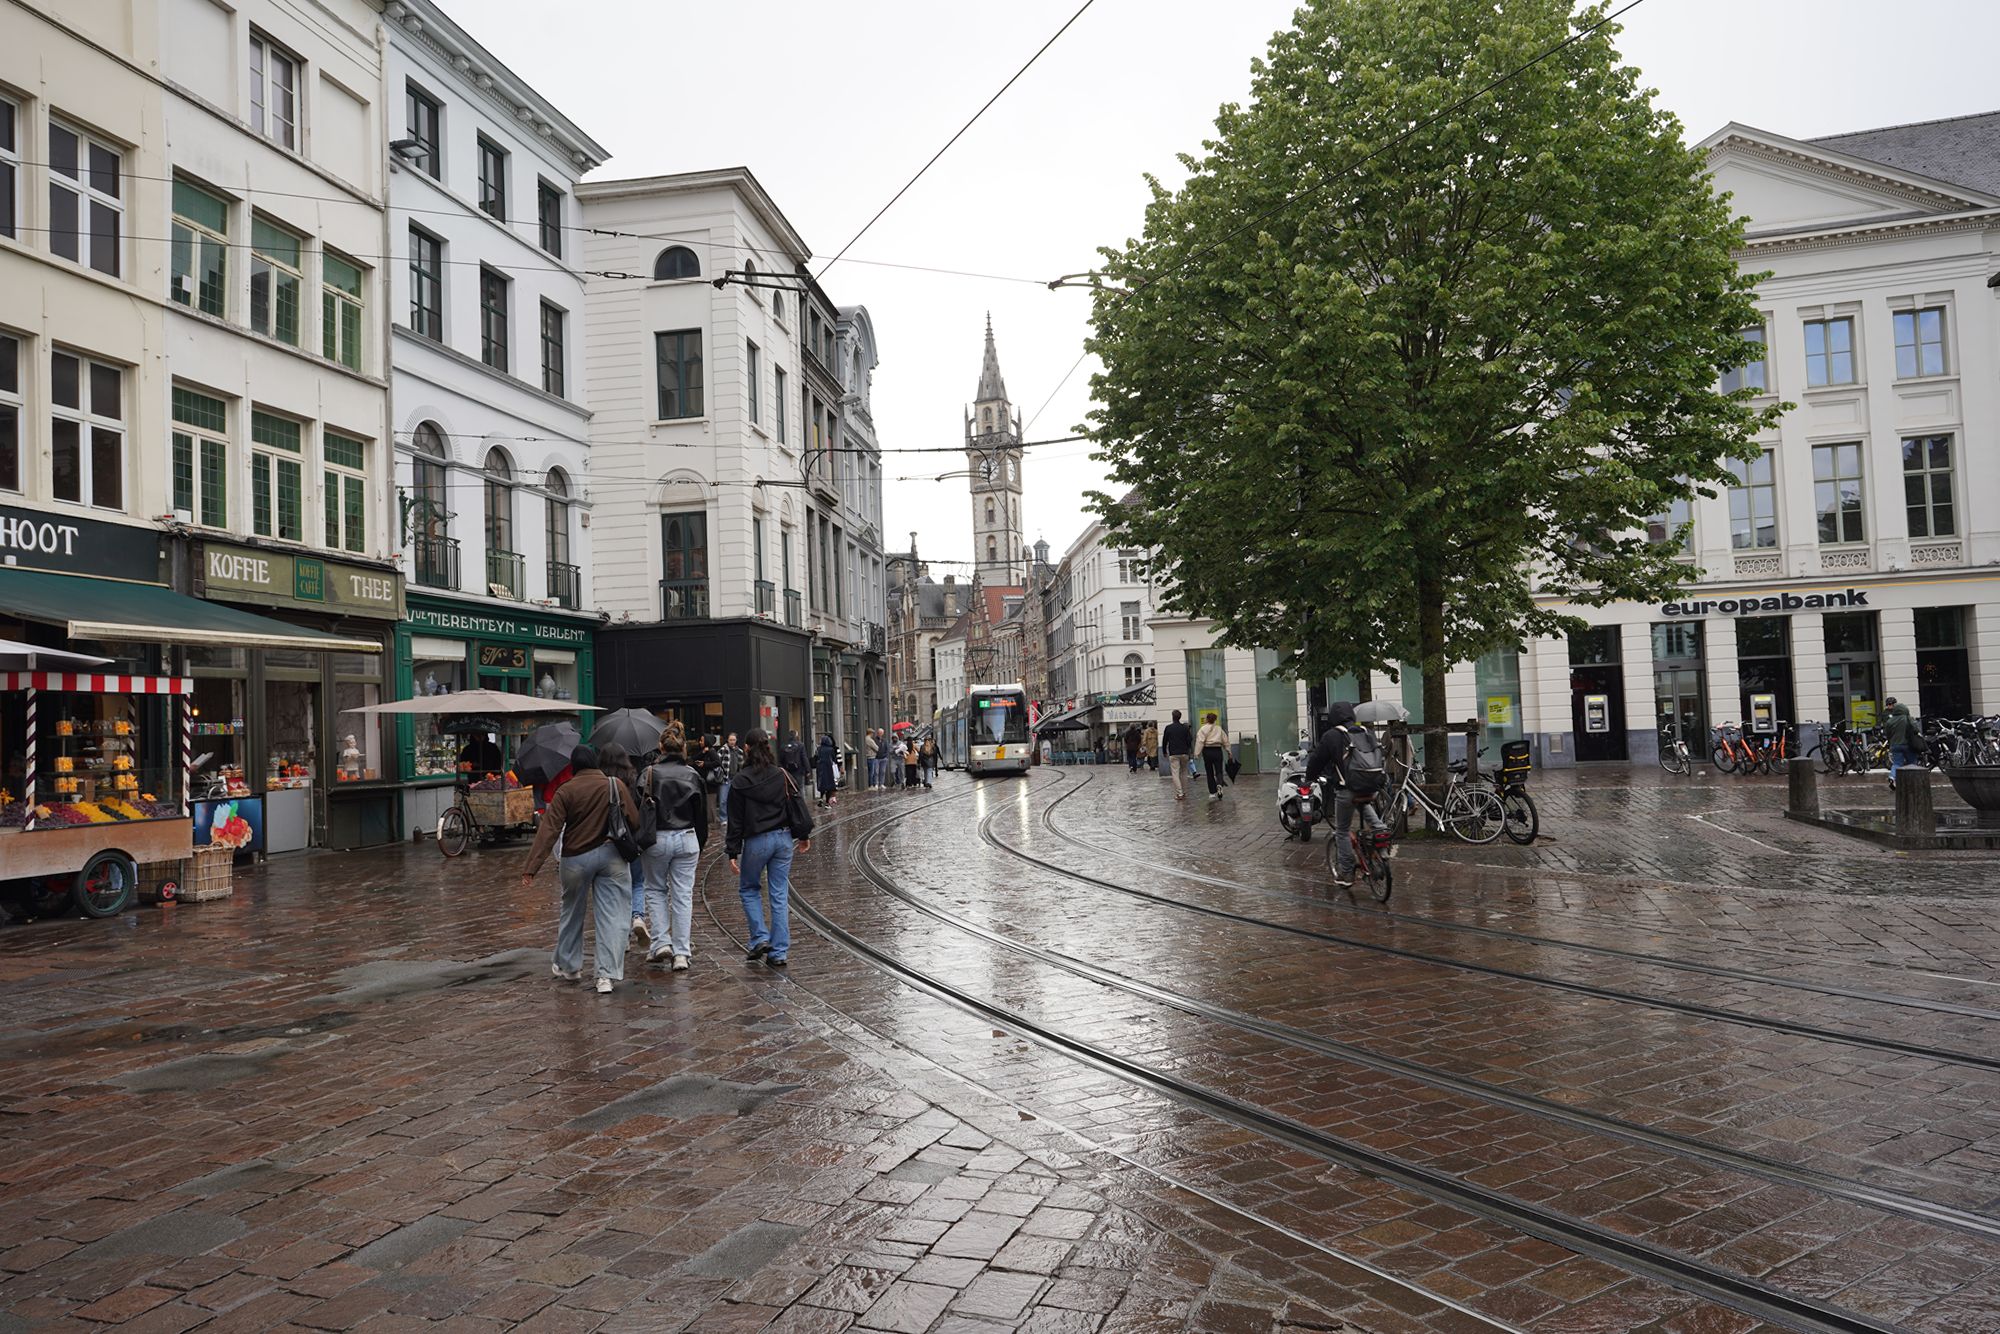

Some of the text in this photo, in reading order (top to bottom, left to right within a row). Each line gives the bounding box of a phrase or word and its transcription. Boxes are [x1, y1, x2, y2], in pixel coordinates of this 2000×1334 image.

[0, 516, 79, 555] HOOT
[209, 552, 393, 601] KOFFIE THEE
[1661, 588, 1869, 616] europabank
[427, 612, 515, 634] TIERENTEYN
[534, 625, 586, 641] VERLENT
[512, 649, 525, 667] 3
